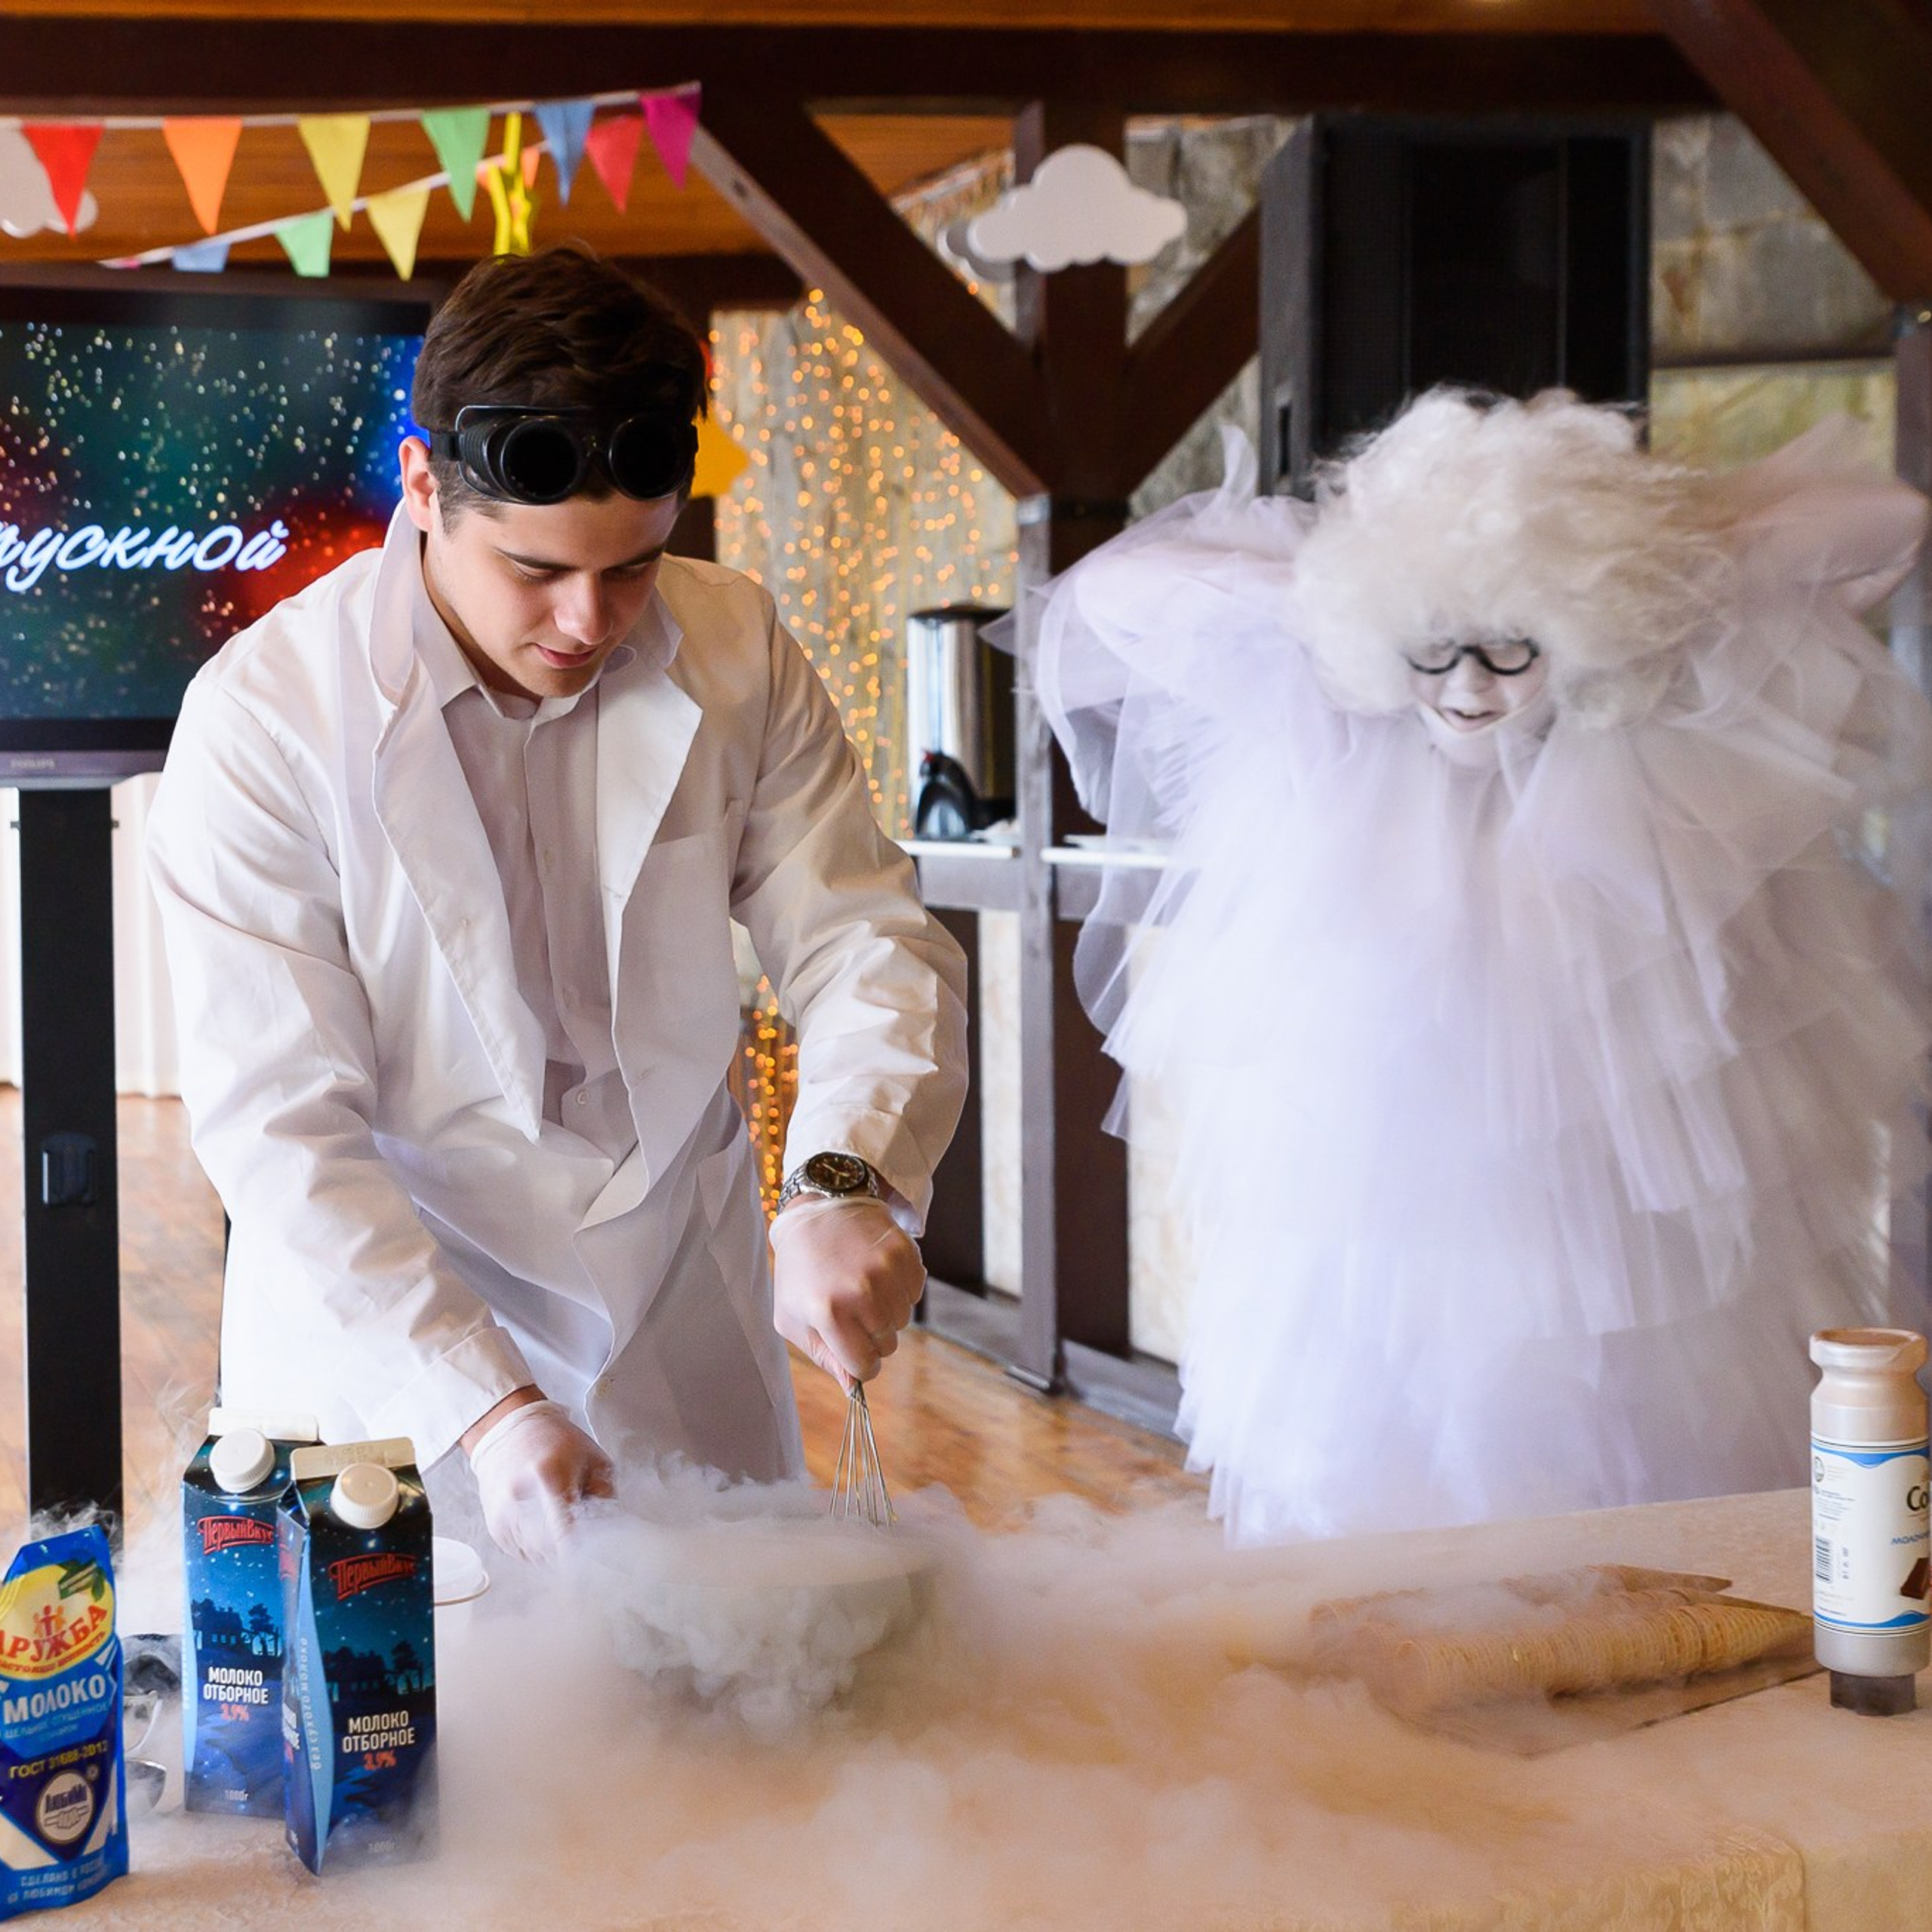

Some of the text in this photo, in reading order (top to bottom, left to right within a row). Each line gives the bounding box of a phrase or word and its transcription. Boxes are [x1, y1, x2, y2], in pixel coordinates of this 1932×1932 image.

[208, 1666, 263, 1687] МОЛОКО
[4, 1674, 106, 1725] МОЛОКО
[203, 1683, 269, 1704] ОТБОРНОЕ
[349, 1710, 409, 1734] МОЛОКО
[343, 1727, 416, 1753] ОТБОРНОЕ
[8, 1760, 45, 1779] ГОСТ
